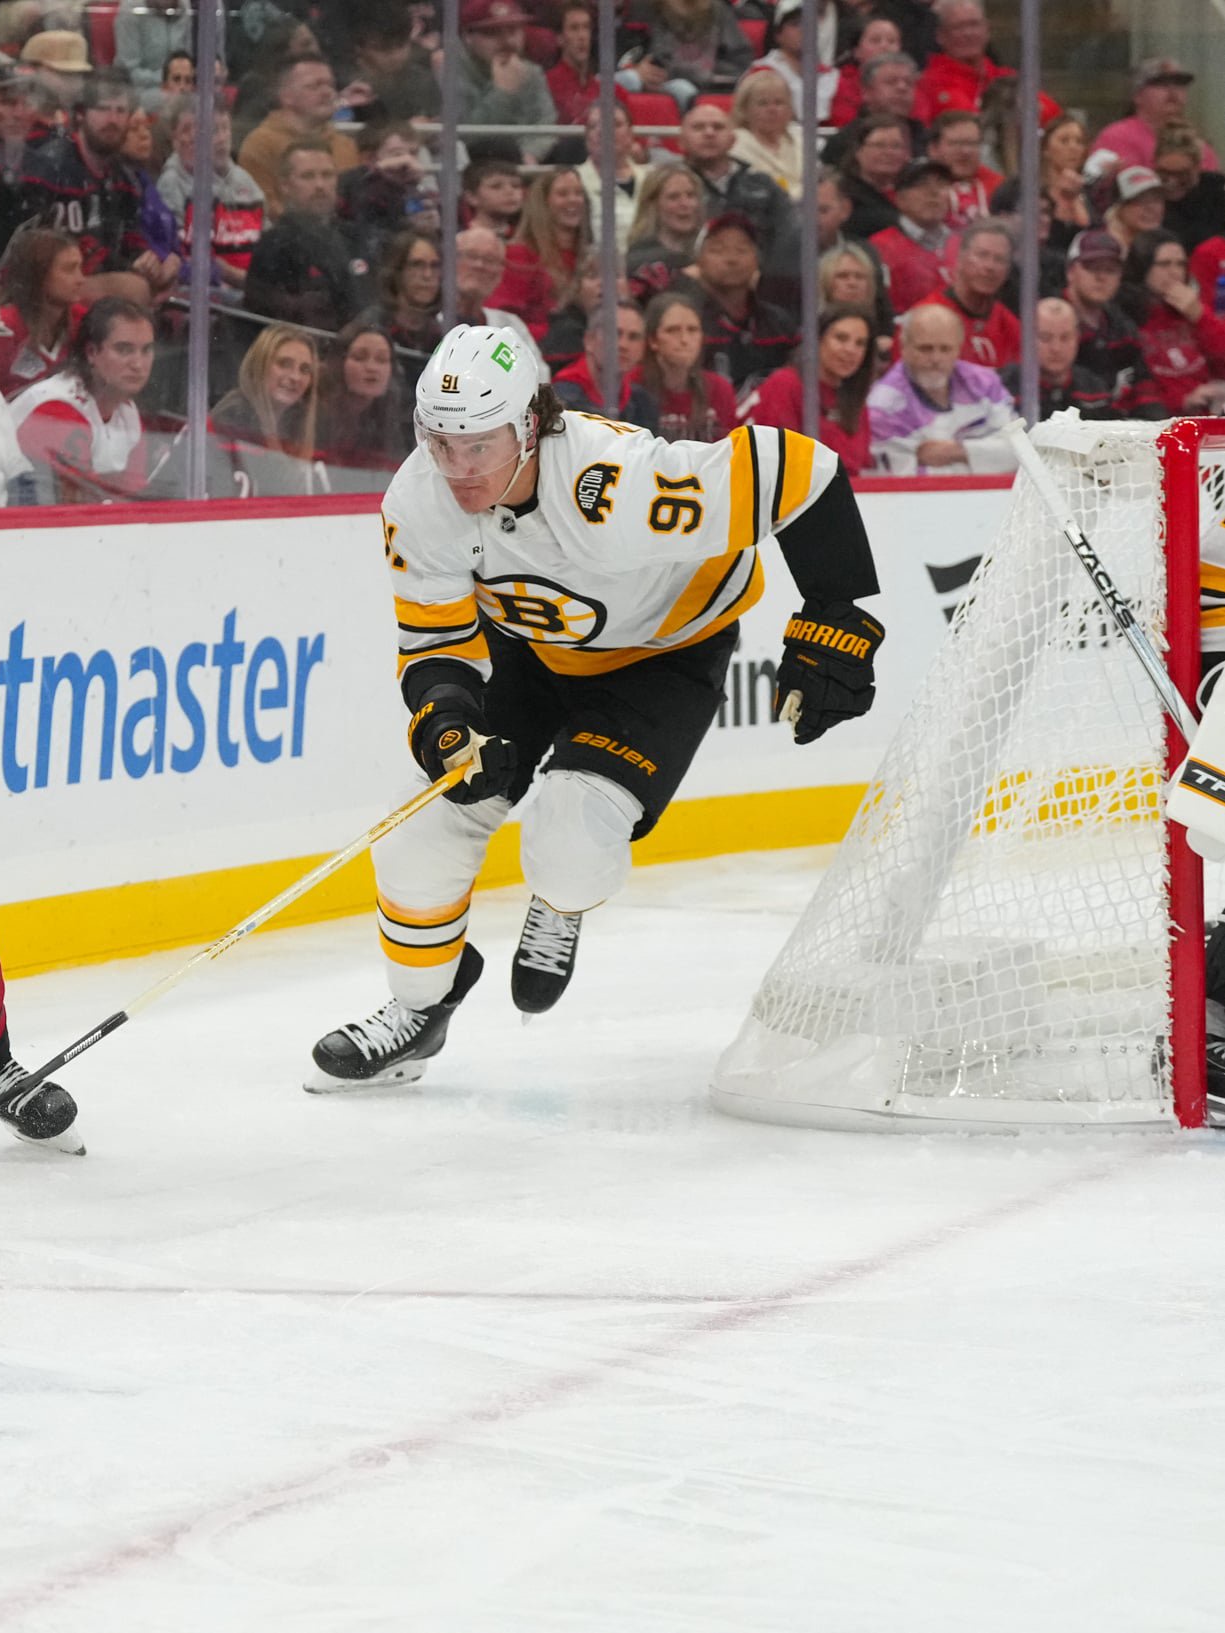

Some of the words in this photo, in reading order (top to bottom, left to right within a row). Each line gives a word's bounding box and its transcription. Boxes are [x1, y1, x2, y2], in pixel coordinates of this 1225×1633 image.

[441, 374, 459, 390] 91
[578, 469, 604, 510] BOSTON
[648, 472, 705, 535] 91
[1075, 533, 1136, 629] TACKS
